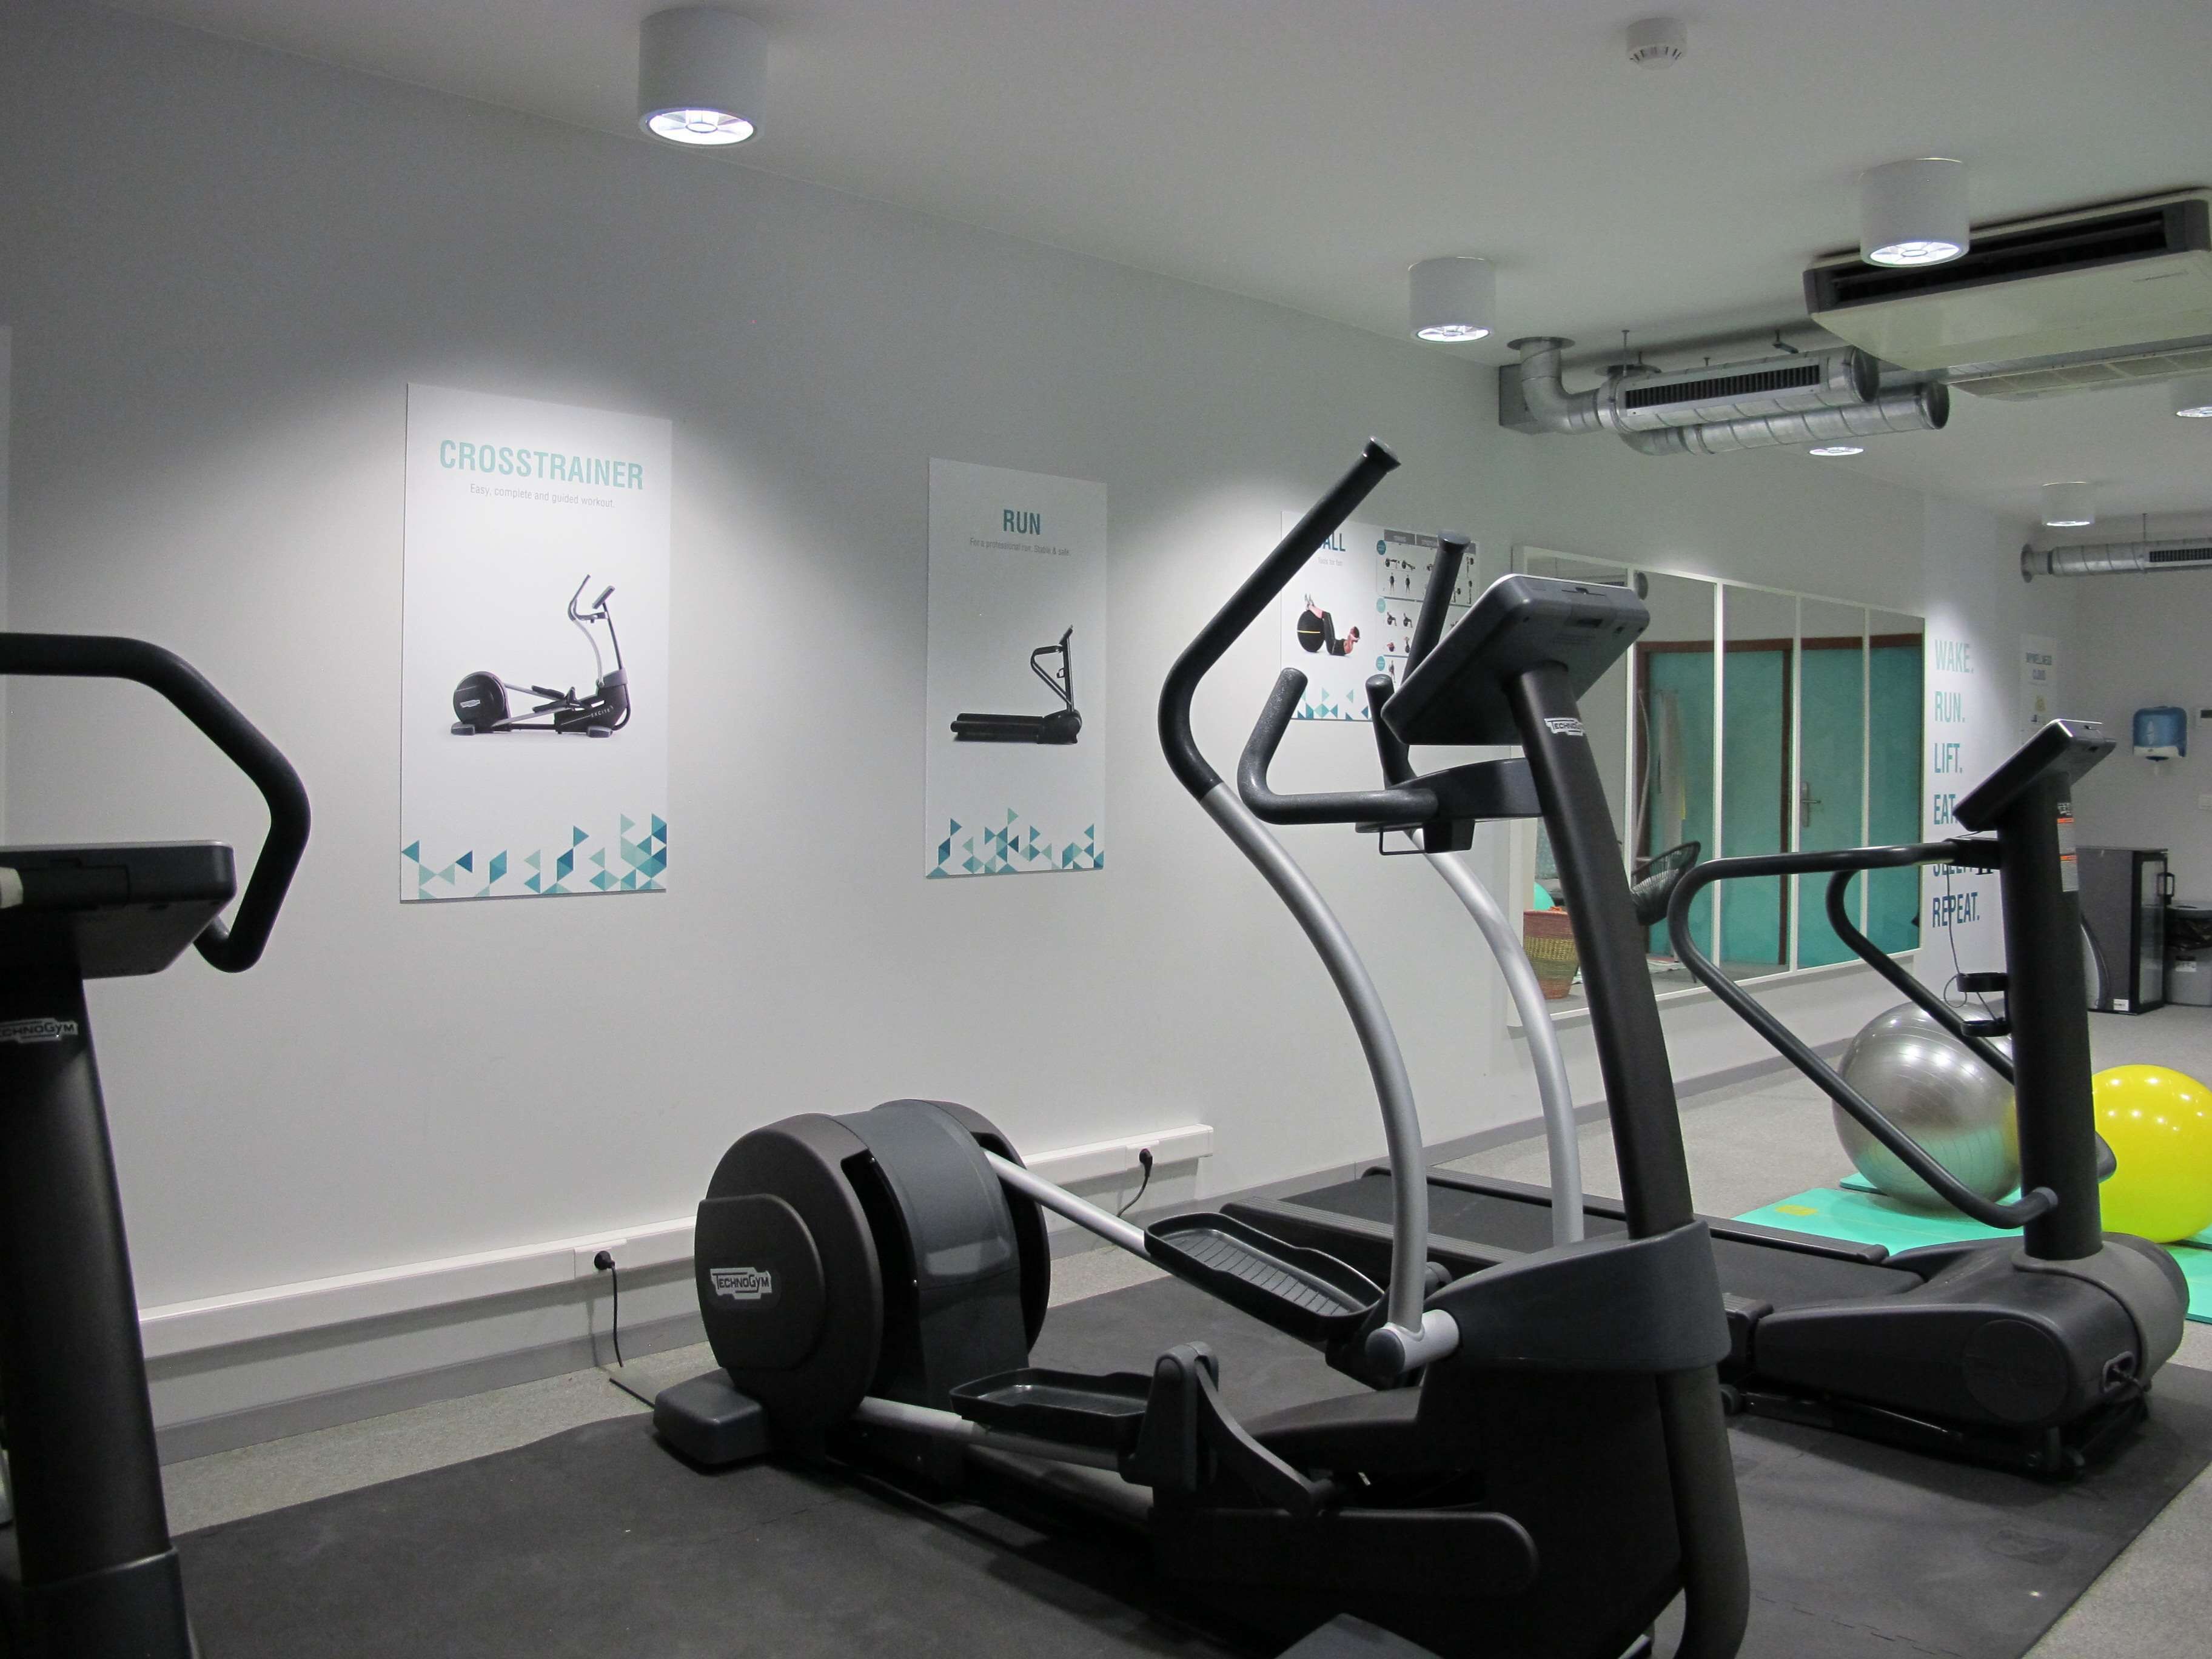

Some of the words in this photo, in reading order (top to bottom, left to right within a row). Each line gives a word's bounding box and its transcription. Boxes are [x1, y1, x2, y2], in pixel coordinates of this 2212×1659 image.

[440, 440, 643, 490] CROSSTRAINER
[470, 483, 491, 496] Easy,
[494, 488, 532, 500] complete
[534, 491, 549, 501] and
[552, 494, 578, 504] guided
[581, 496, 615, 508] workout.
[1004, 509, 1041, 535] RUN
[1321, 532, 1346, 552] ALL
[1935, 639, 1974, 674] WAKE.
[1935, 691, 1965, 722] RUN.
[1934, 743, 1963, 774] LIFT.
[1932, 891, 1980, 928] REPEAT.
[712, 1272, 770, 1293] TECHNOGYM
